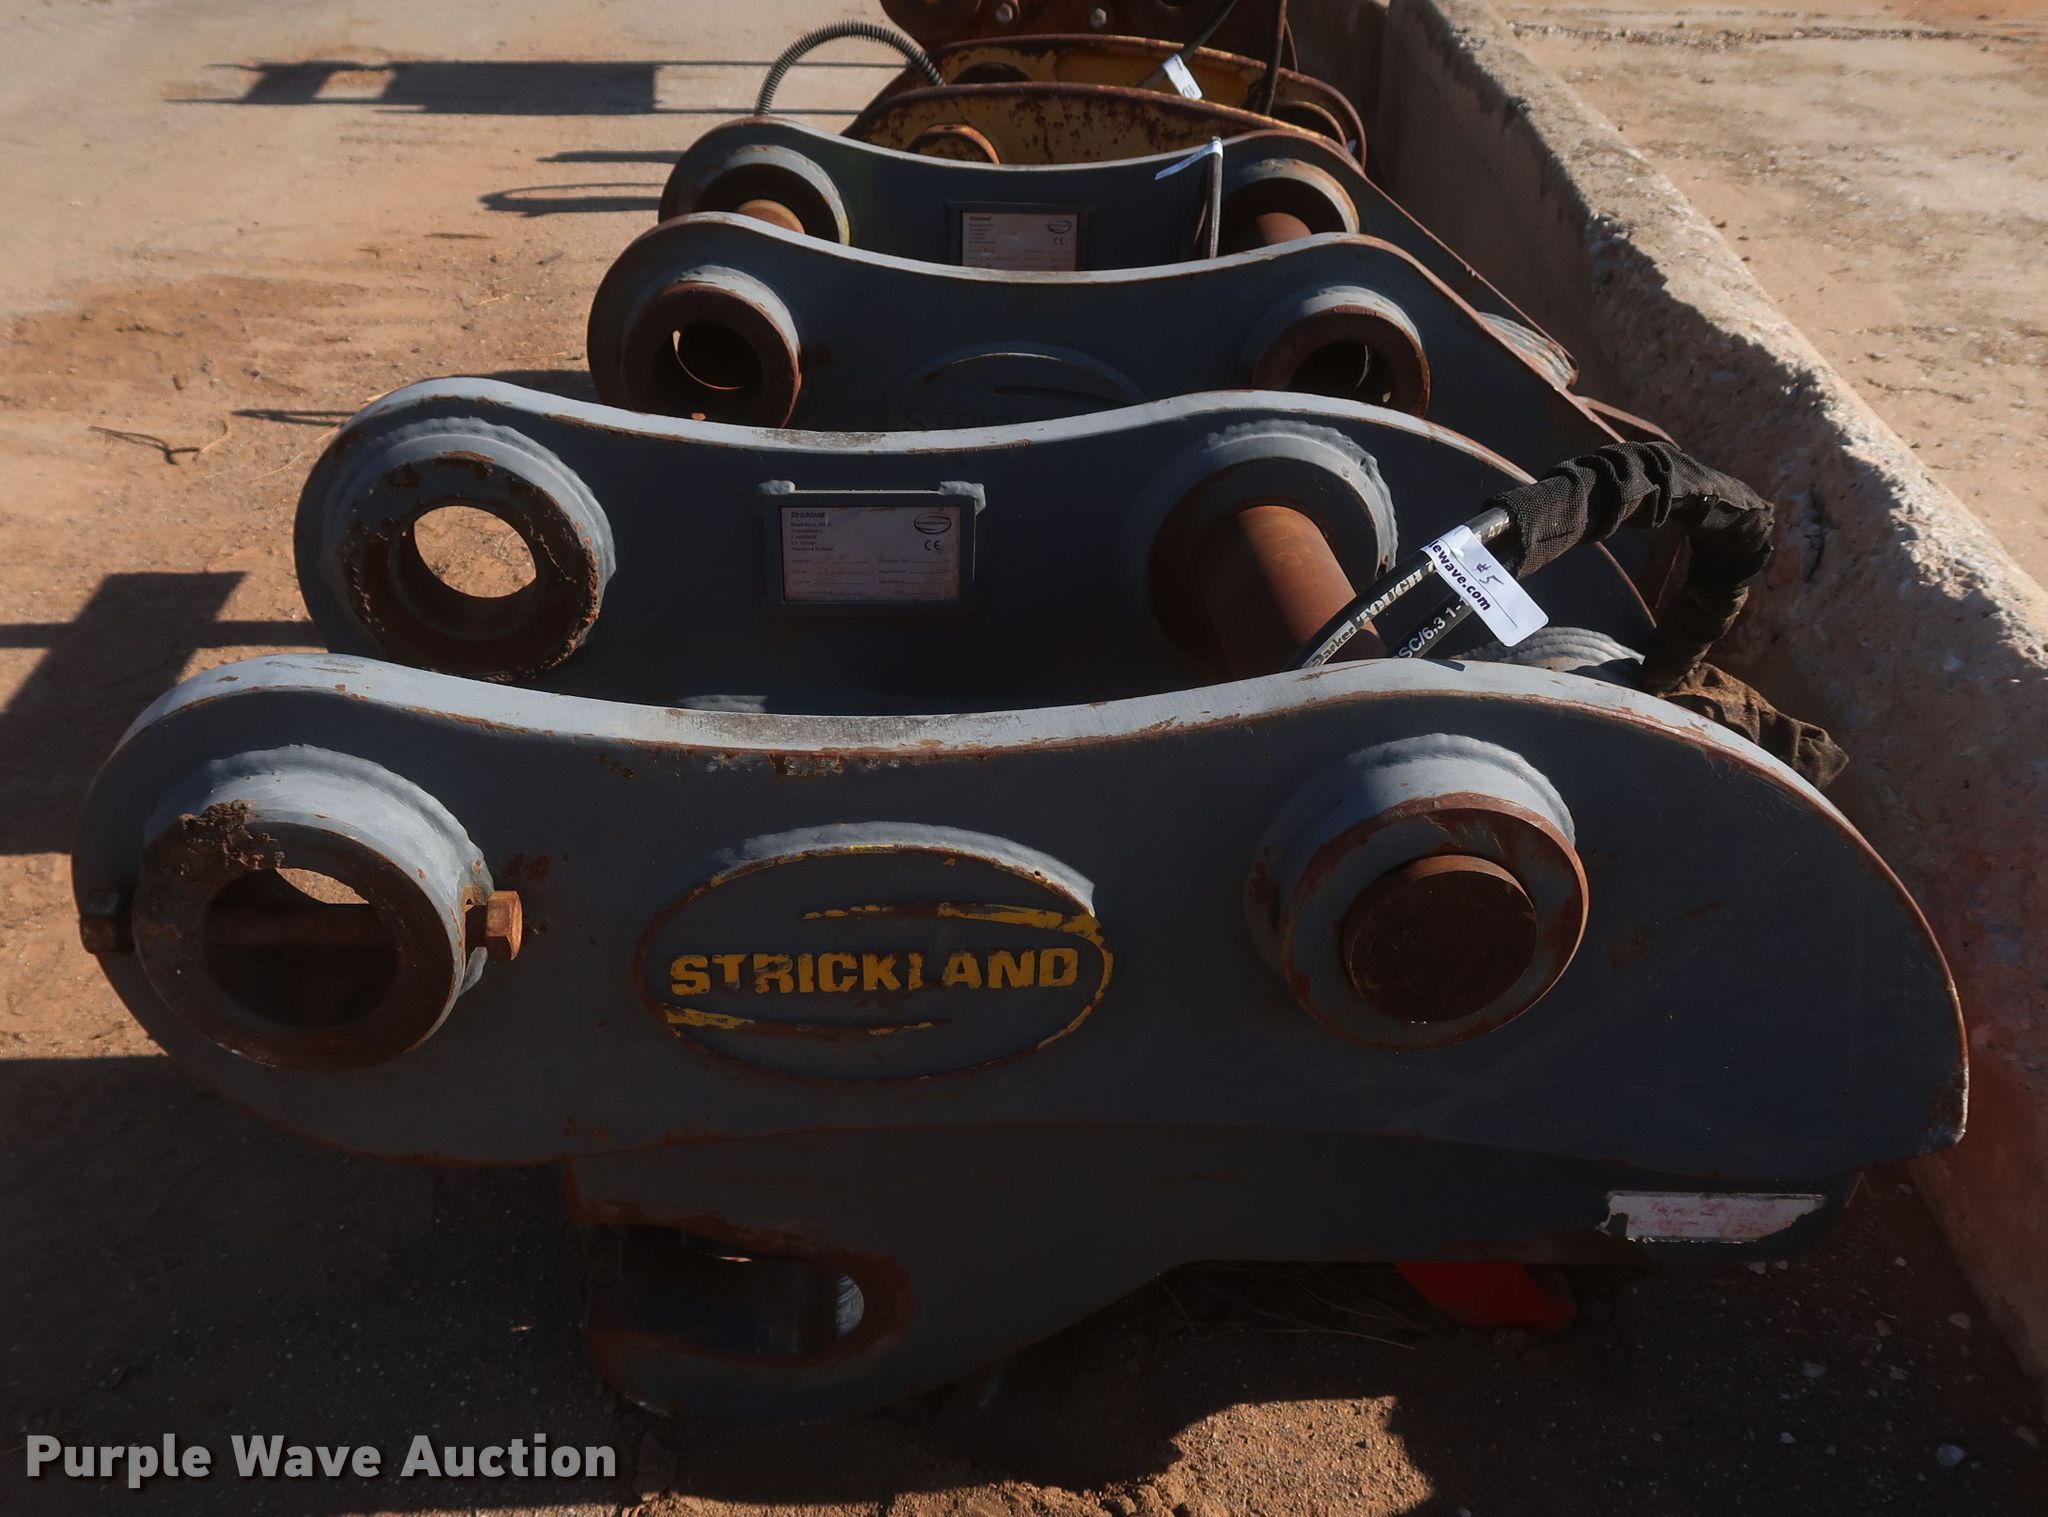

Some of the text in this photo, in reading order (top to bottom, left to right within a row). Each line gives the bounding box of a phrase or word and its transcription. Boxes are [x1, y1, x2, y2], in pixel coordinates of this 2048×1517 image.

[1356, 568, 1423, 624] TOUGH
[1392, 616, 1446, 658] SC/6,3
[669, 946, 1080, 997] STRICKLAND
